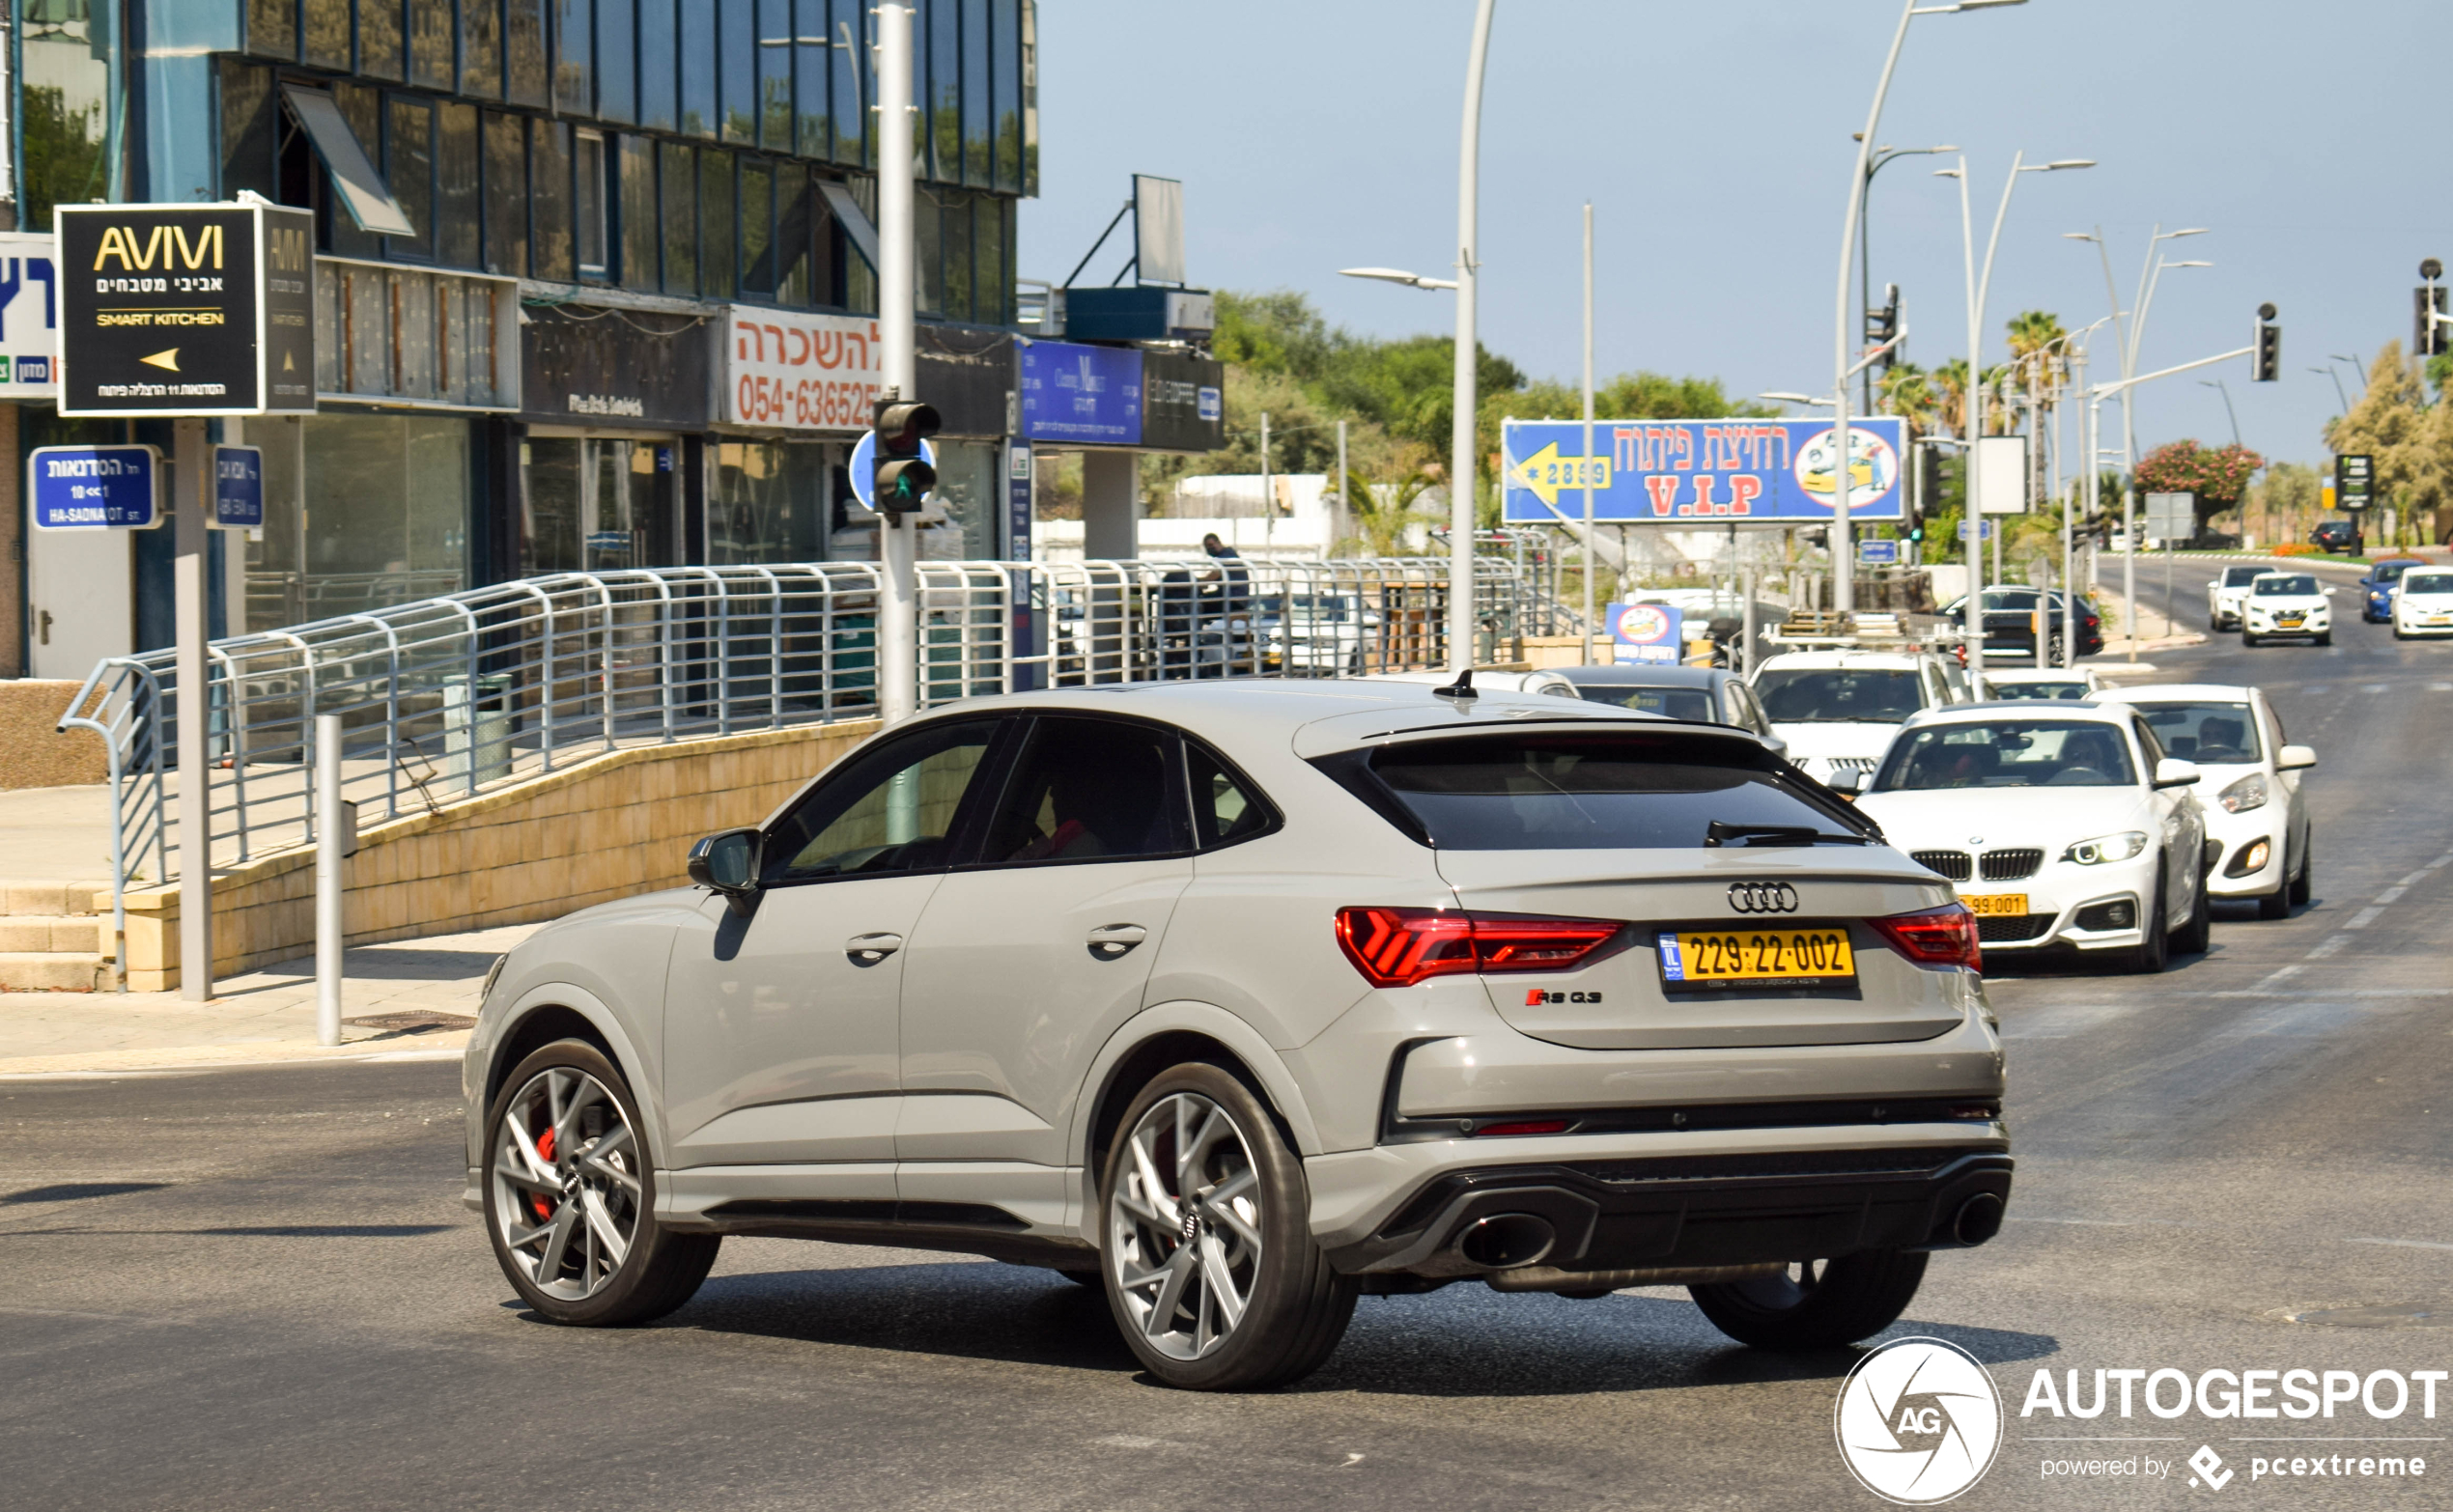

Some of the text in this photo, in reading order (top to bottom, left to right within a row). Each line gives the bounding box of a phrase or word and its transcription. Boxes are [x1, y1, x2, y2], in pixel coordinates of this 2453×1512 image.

[93, 225, 223, 271] AVIVI
[97, 277, 223, 294] אביבי מטבחים
[97, 313, 224, 326] SMART KITCHEN
[739, 374, 881, 427] 054-636525
[1614, 425, 1790, 471] רחיצת פיתוח
[47, 459, 123, 477] הסדנאות
[1645, 474, 1762, 517] V.I.P
[1535, 992, 1603, 1004] RS Q3
